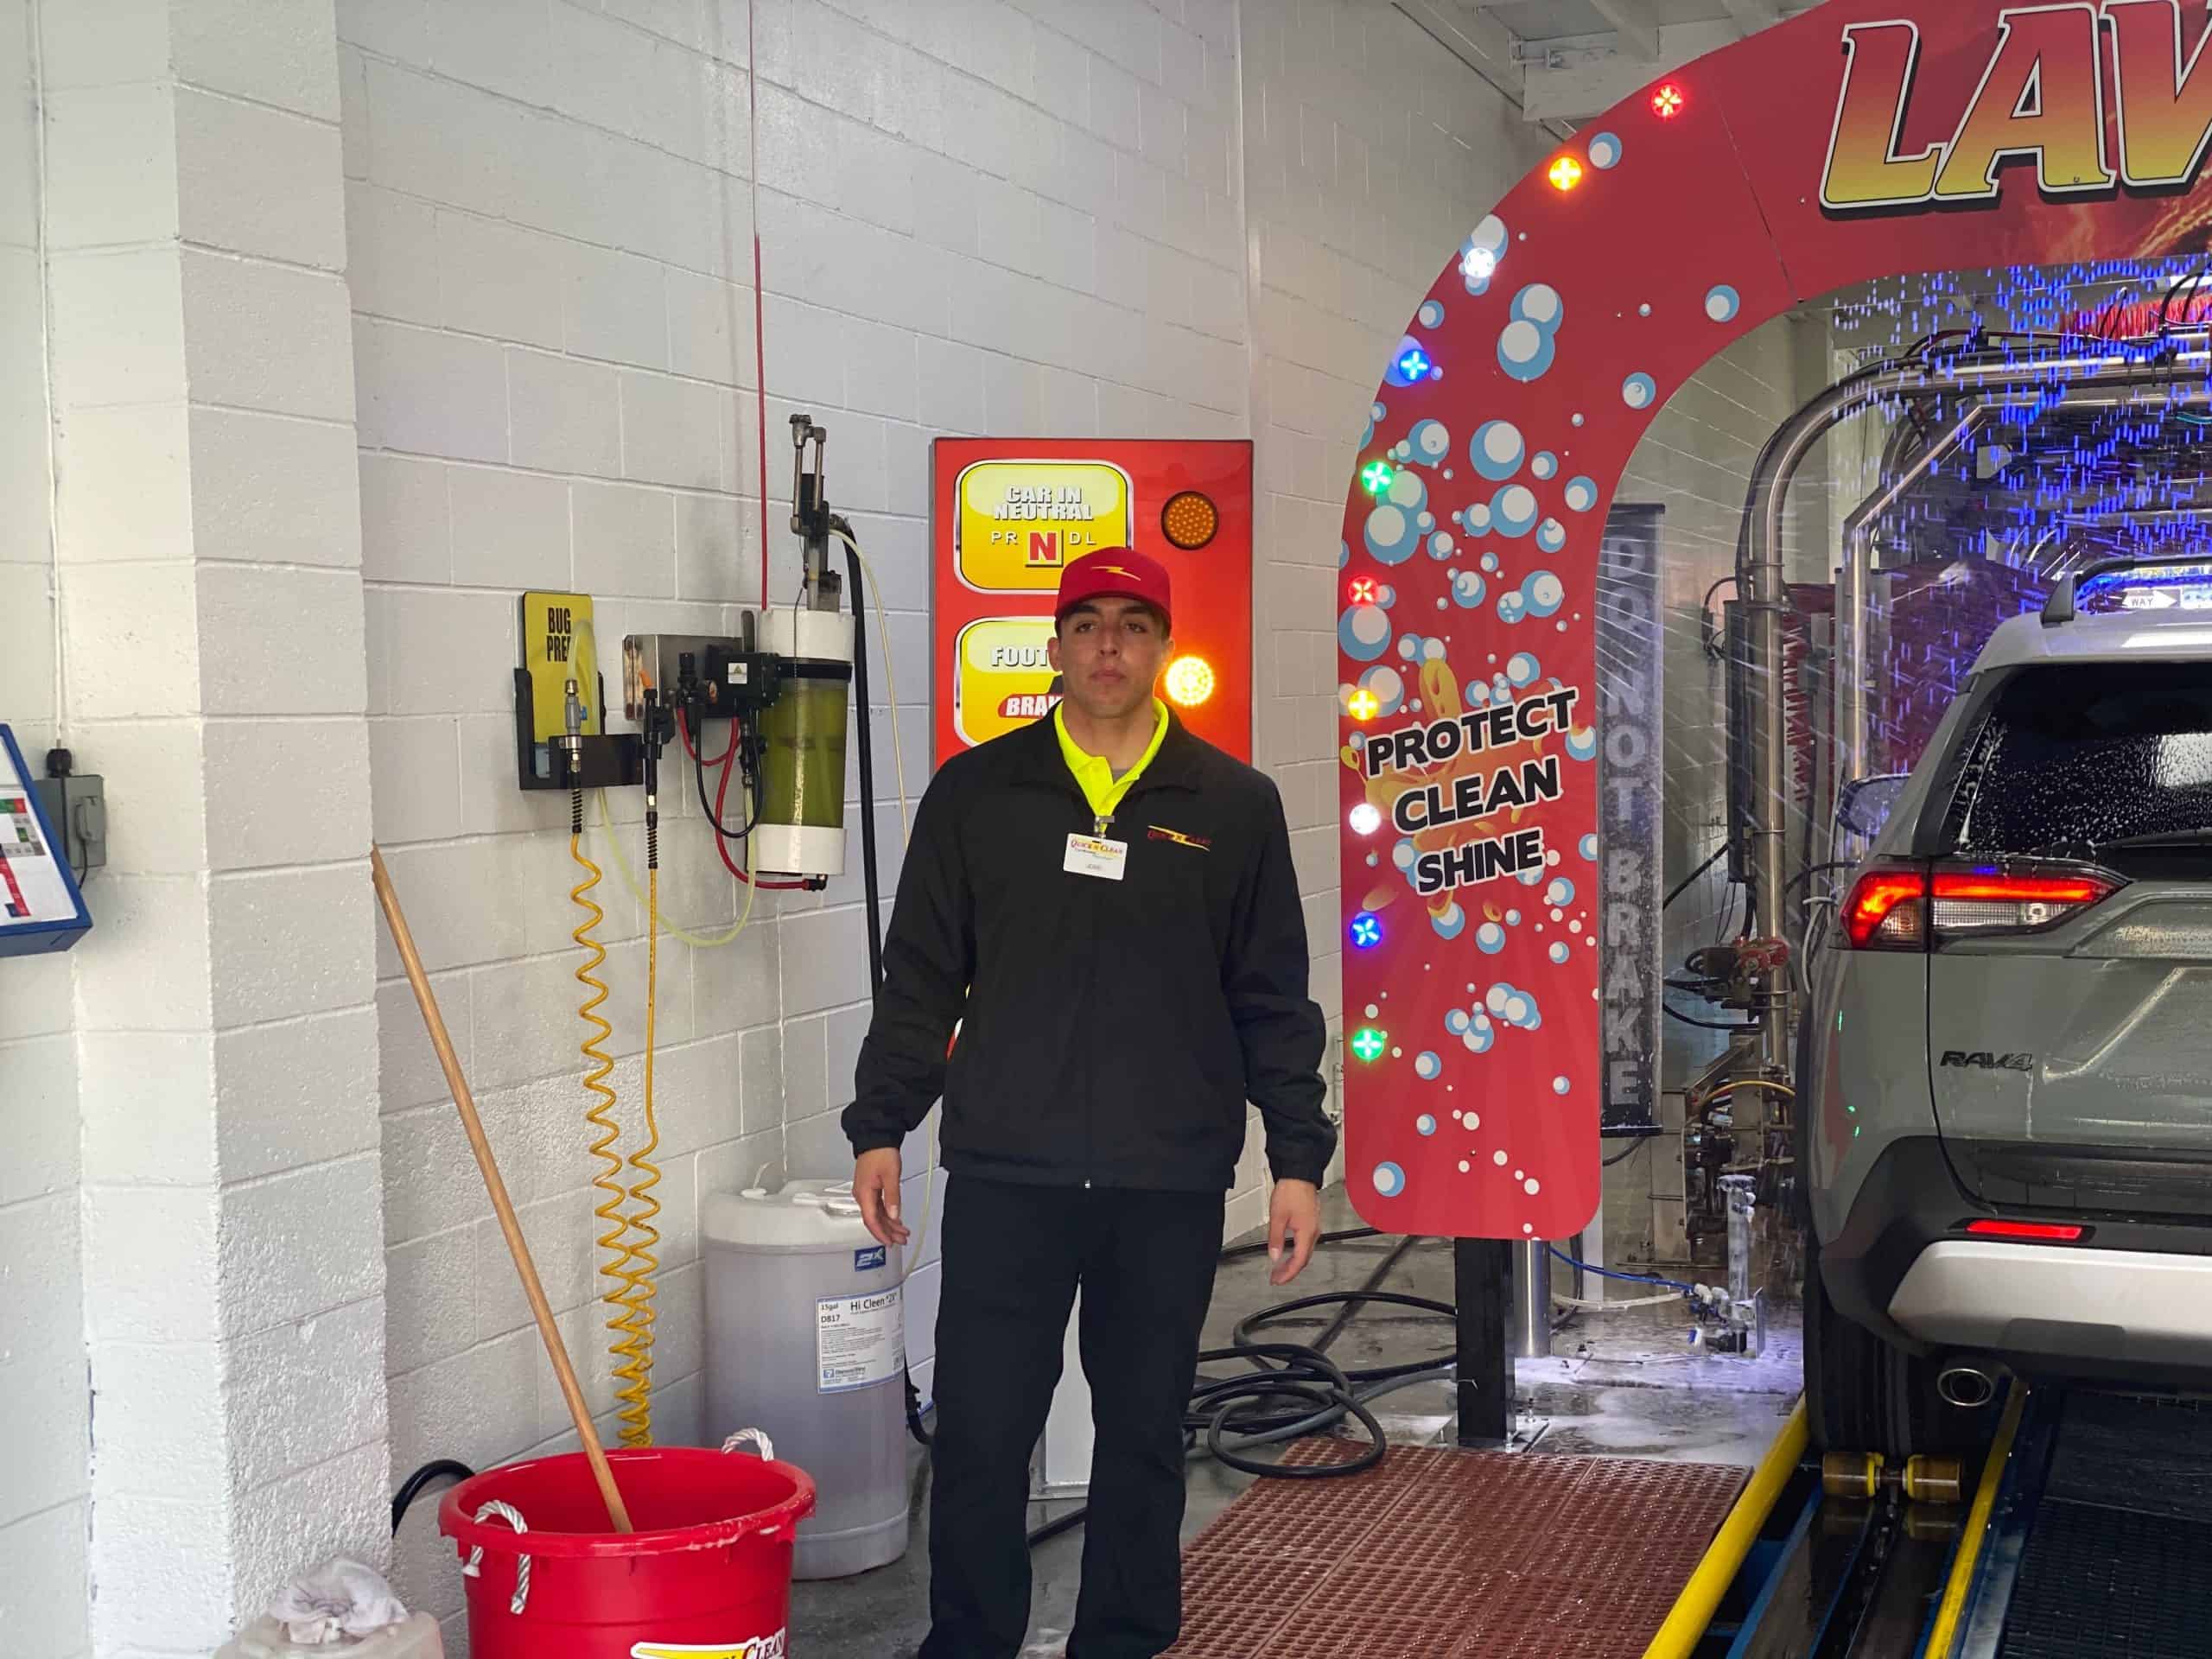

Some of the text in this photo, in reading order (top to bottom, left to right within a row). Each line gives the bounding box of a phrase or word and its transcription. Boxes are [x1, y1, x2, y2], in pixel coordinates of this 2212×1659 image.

[1007, 486, 1083, 503] CAR IN
[995, 504, 1094, 521] NEUTRAL
[1029, 532, 1057, 560] N
[548, 607, 572, 633] BUG
[991, 645, 1049, 666] FOOT
[1367, 688, 1579, 777] PROTECT
[1605, 669, 1647, 823] NOT
[1394, 756, 1560, 833] CLEAN
[1416, 829, 1545, 894] SHINE
[1605, 847, 1645, 1107] BRAKE
[1940, 1050, 2033, 1071] RAV4
[850, 1300, 861, 1311] Hi
[863, 1298, 885, 1309] Cleen
